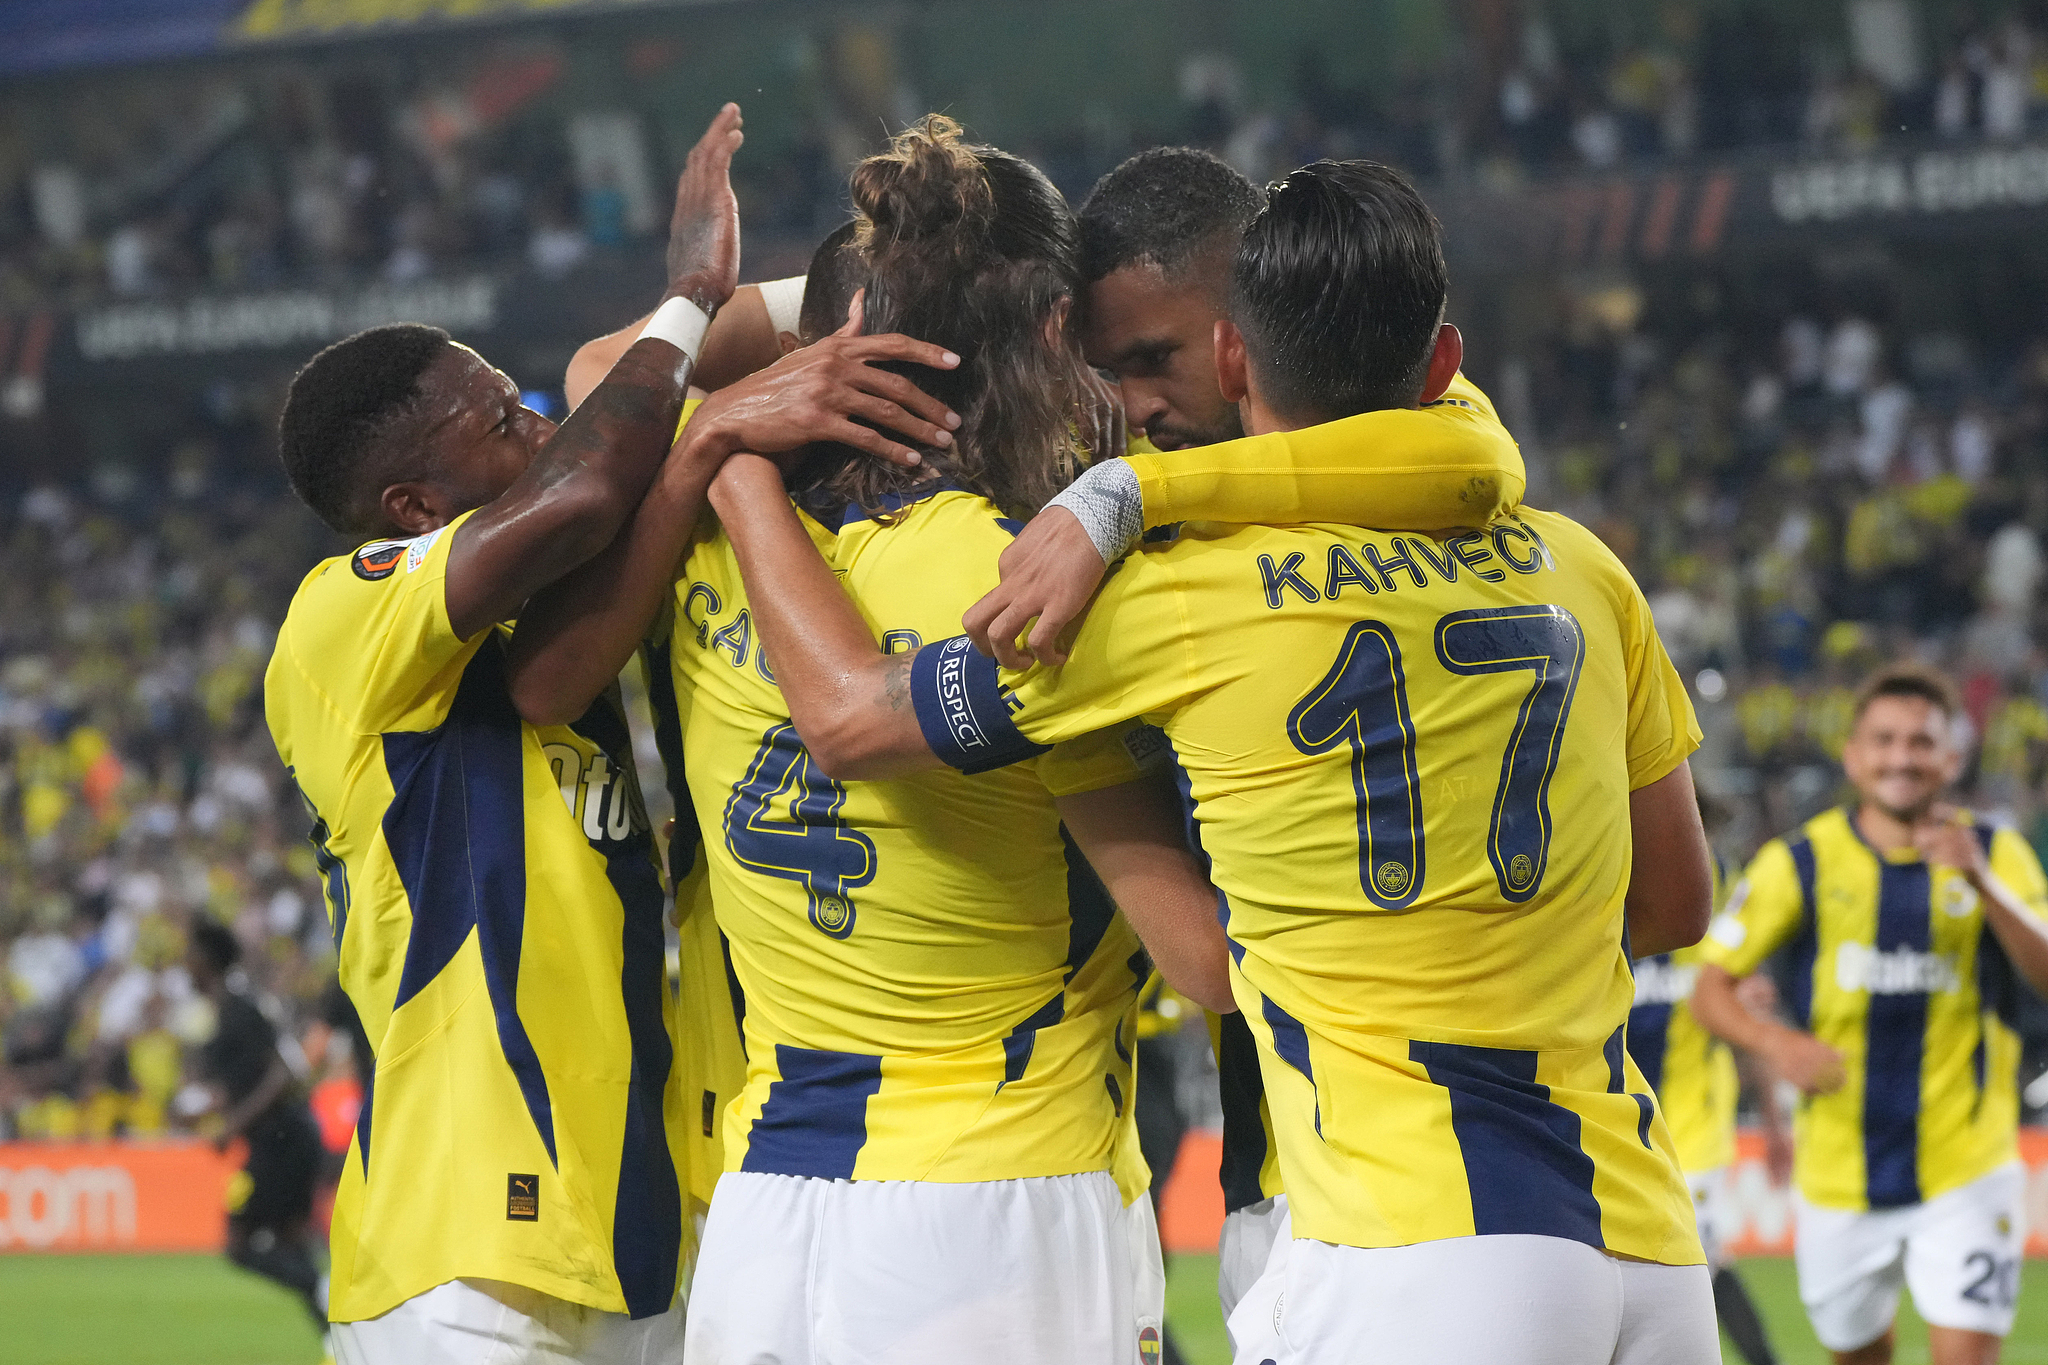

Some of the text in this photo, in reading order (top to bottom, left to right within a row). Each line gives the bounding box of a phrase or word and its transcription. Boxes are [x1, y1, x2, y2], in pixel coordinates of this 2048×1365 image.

[942, 657, 985, 748] RESPECT
[1286, 603, 1586, 911] 17
[722, 717, 878, 940] 4
